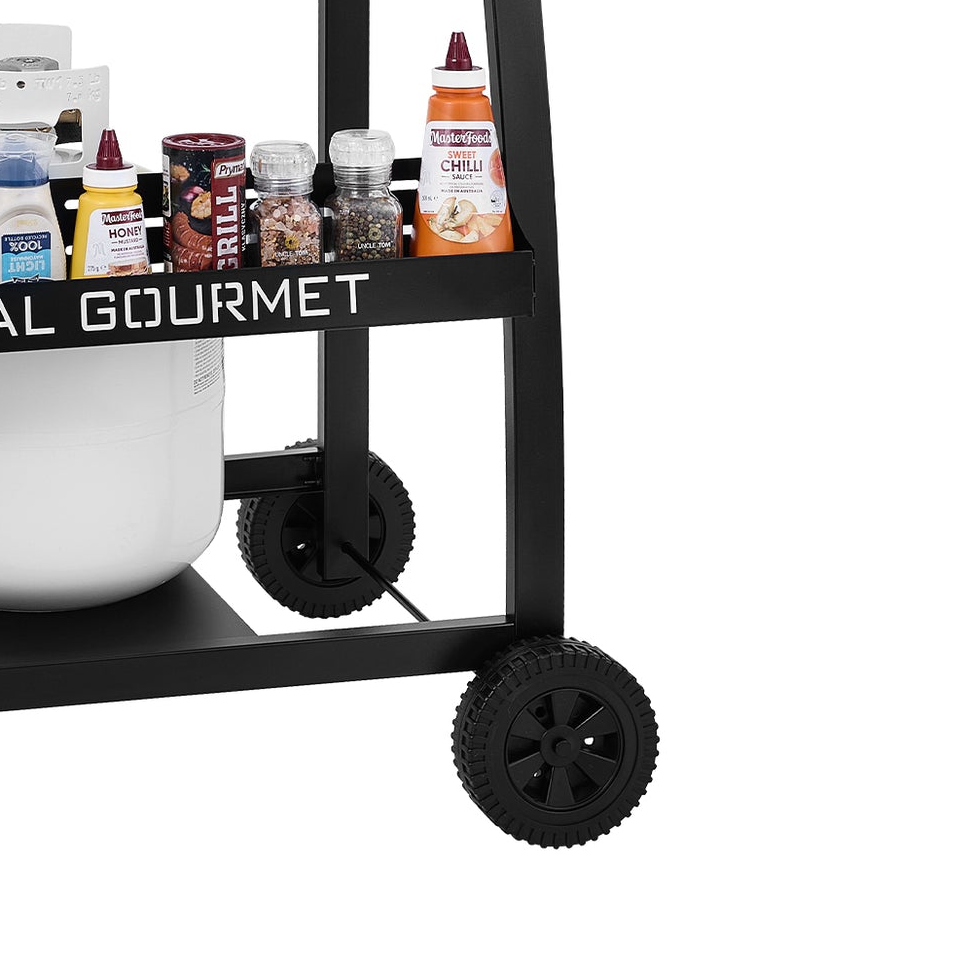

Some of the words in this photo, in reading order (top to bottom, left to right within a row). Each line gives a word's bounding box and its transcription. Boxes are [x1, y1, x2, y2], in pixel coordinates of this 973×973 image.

[447, 151, 477, 159] SWEET
[218, 162, 246, 177] Pryma
[440, 159, 483, 172] CHILLI
[108, 226, 142, 239] HONEY
[215, 185, 239, 271] GRILL
[8, 240, 43, 252] 100%
[7, 260, 46, 273] LIGHT
[80, 273, 371, 332] GOURMET
